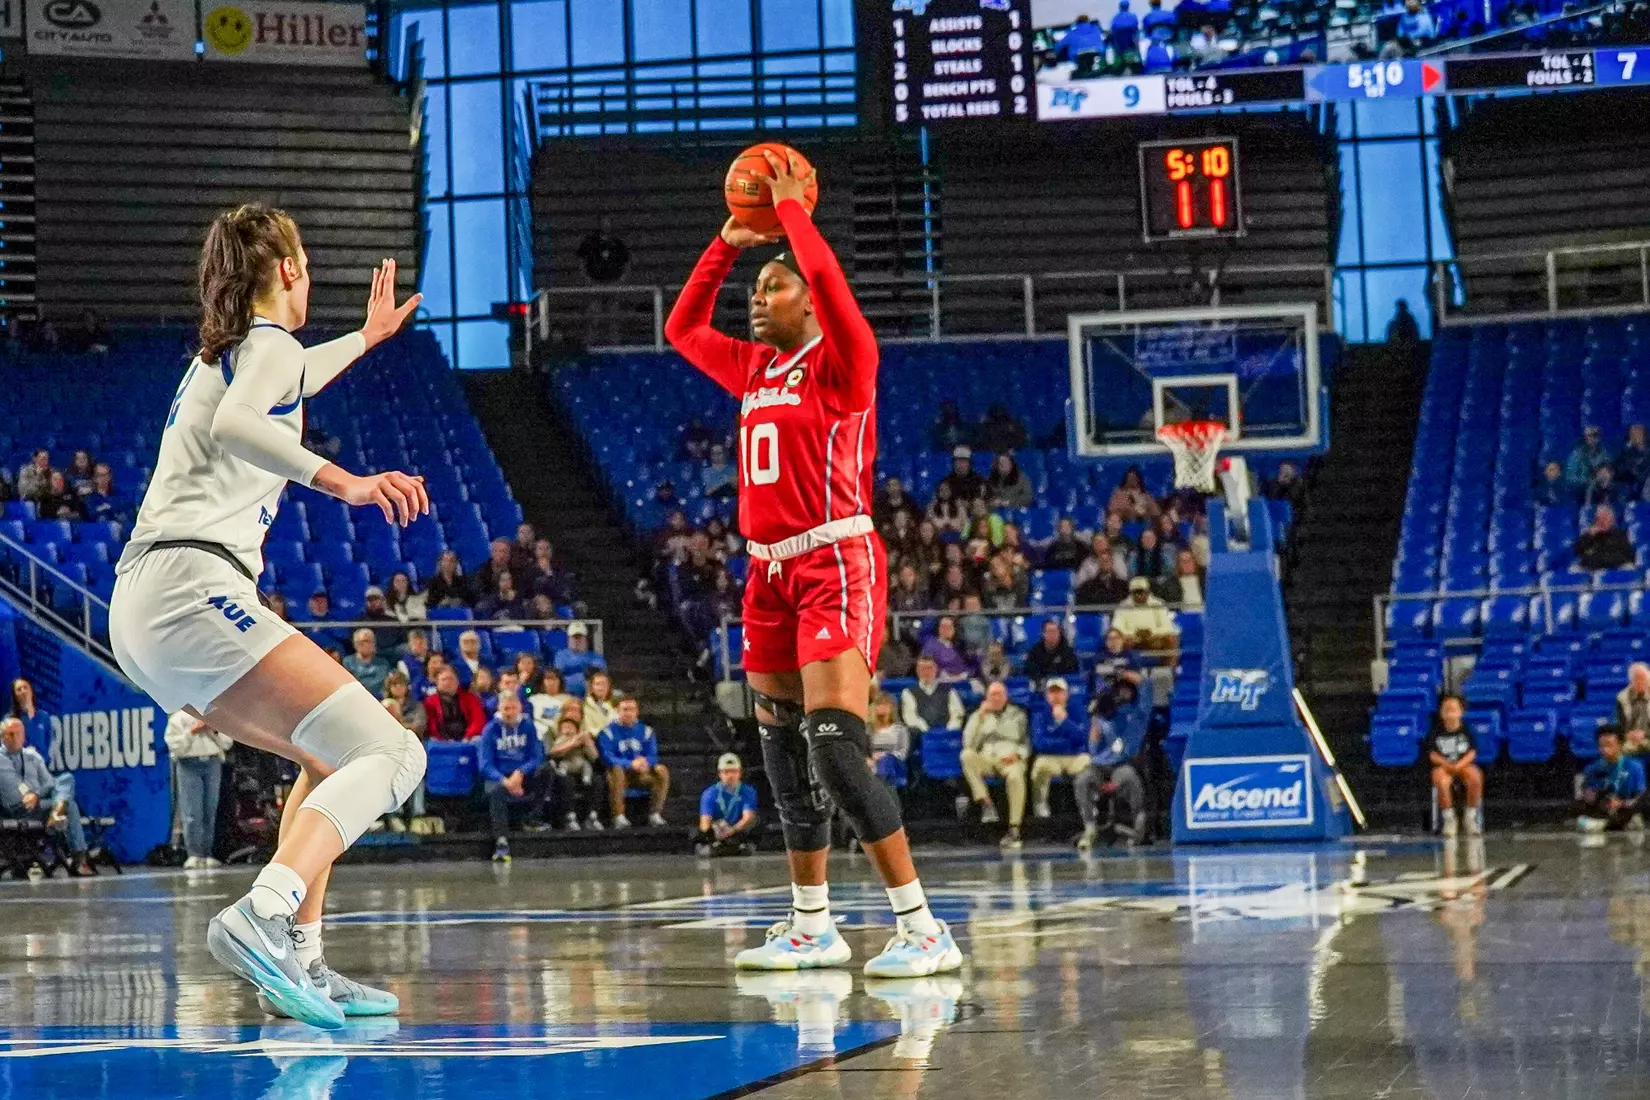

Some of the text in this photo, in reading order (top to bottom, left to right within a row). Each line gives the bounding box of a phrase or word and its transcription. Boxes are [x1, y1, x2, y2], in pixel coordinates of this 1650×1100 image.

[255, 12, 364, 47] Hiller
[929, 15, 982, 33] ASSISTS
[1008, 9, 1020, 29] 1
[931, 37, 982, 54] BLOCKS
[1008, 31, 1022, 51] 0
[894, 53, 1023, 80] 2 STEALS 1
[1348, 61, 1404, 88] 5:10
[1617, 52, 1637, 80] 7
[894, 74, 1025, 101] 0 BENCH PTS 0
[1122, 84, 1140, 108] 9
[896, 103, 909, 122] 5
[921, 102, 965, 119] TOTAL
[1014, 95, 1028, 114] 2
[1166, 146, 1229, 181] 5:10
[1177, 179, 1225, 229] 11
[740, 422, 780, 487] 10
[48, 706, 156, 771] RUEBLUE
[1192, 779, 1302, 811] Ascend
